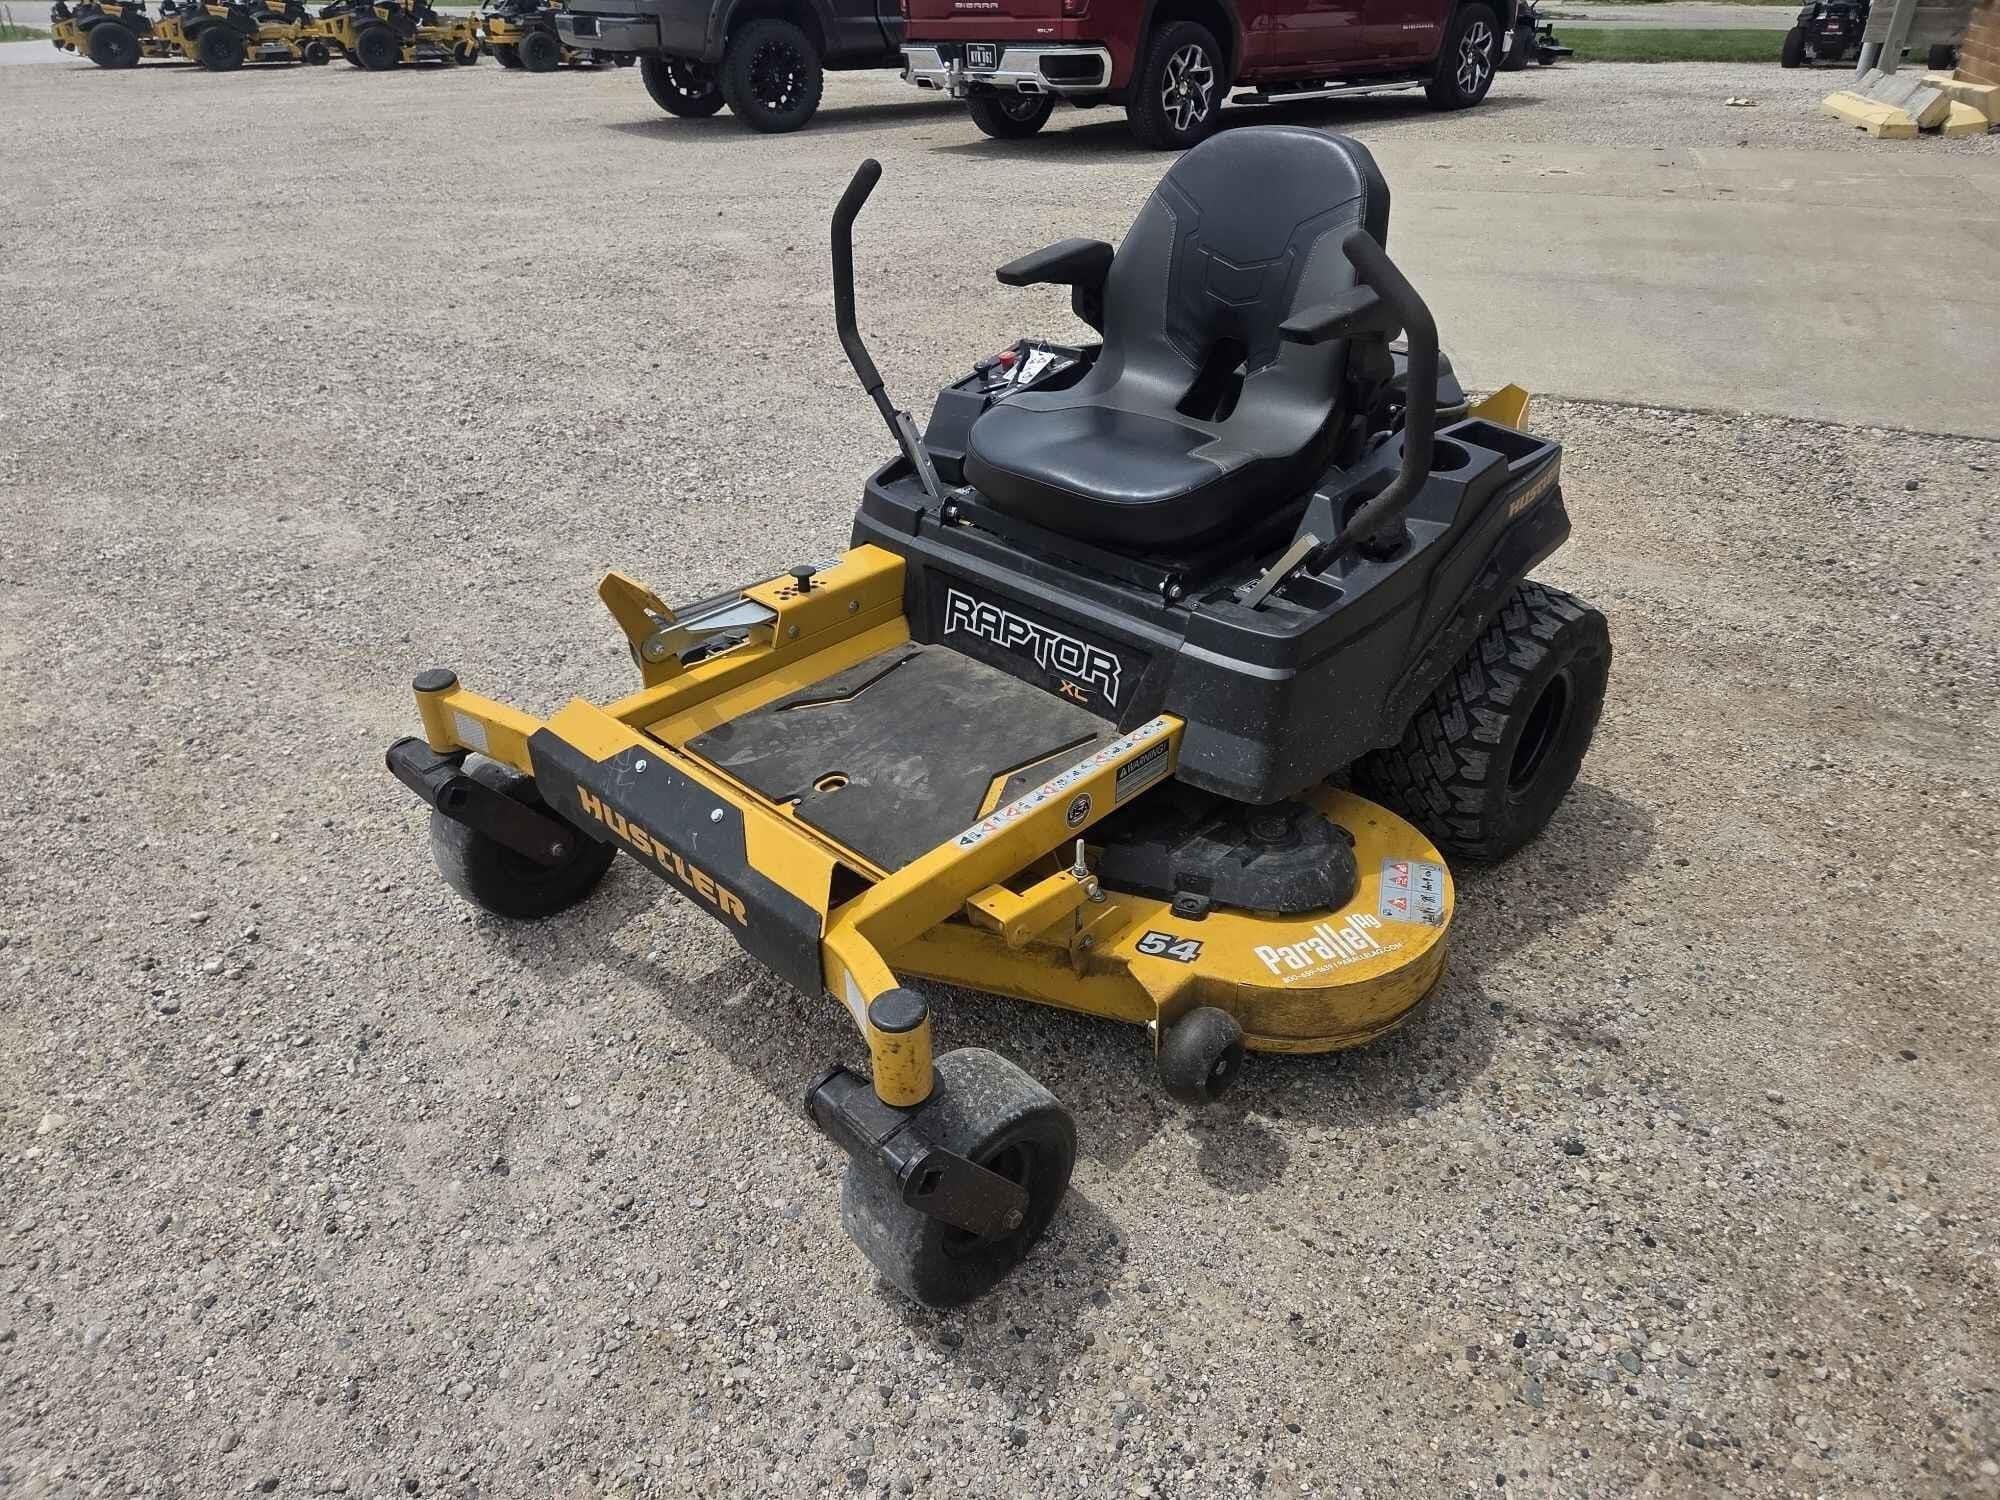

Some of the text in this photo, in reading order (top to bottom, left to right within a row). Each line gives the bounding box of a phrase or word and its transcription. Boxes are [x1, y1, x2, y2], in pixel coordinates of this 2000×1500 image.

[944, 587, 1122, 708] RAPTOR
[576, 784, 748, 928] HUSTLER
[1136, 930, 1204, 963] 54
[1253, 915, 1380, 976] Parallel
